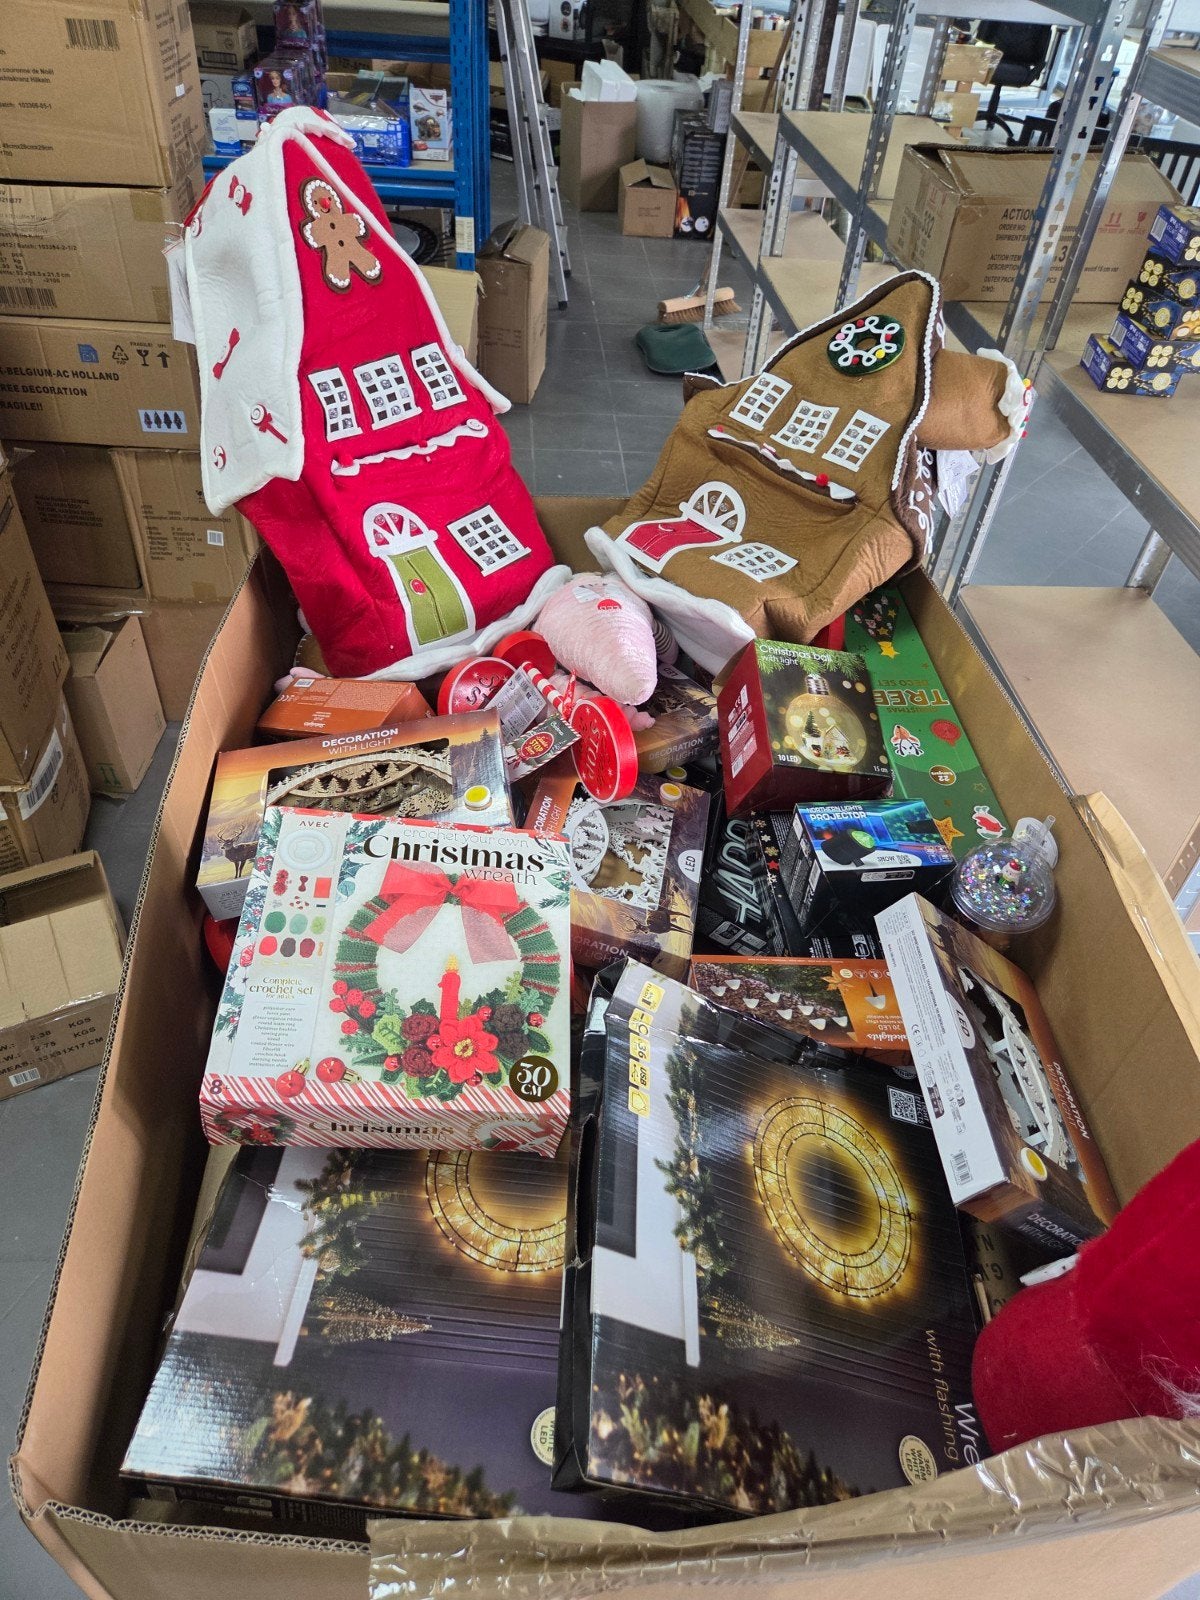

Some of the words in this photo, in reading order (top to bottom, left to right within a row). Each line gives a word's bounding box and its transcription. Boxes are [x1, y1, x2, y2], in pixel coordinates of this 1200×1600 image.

[72, 370, 120, 382] HOLLAND
[22, 385, 88, 397] DECORATION
[759, 644, 812, 661] Christmas
[813, 651, 833, 663] ball
[763, 654, 779, 663] with
[780, 656, 799, 666] light
[322, 728, 399, 749] DECORATION
[328, 741, 358, 756] WITH
[361, 737, 393, 750] LIGHT
[649, 737, 704, 761] DECORATION
[787, 755, 799, 763] LED
[938, 774, 951, 782] 22
[806, 805, 840, 813] NORTHERN
[841, 804, 863, 812] LIGHTS
[810, 811, 867, 821] PROJECTOR
[299, 820, 330, 829] AVEC
[404, 828, 459, 842] crochet
[462, 831, 496, 846] your
[497, 837, 529, 849] own
[363, 834, 545, 873] Christmas
[684, 855, 696, 873] LED
[463, 868, 538, 886] wreath
[249, 984, 294, 995] crochet
[297, 986, 313, 996] set
[263, 976, 303, 986] Complete
[68, 1017, 91, 1028] KGS
[73, 1027, 96, 1038] KGS
[516, 1062, 552, 1087] 30
[521, 1084, 544, 1099] CM
[1053, 1061, 1090, 1140] DECORATION
[308, 1121, 455, 1135] Christmas
[925, 1329, 945, 1373] with
[934, 1378, 959, 1461] flashing
[540, 1425, 548, 1445] LED
[905, 1452, 913, 1472] LED
[910, 1448, 921, 1480] WHITE
